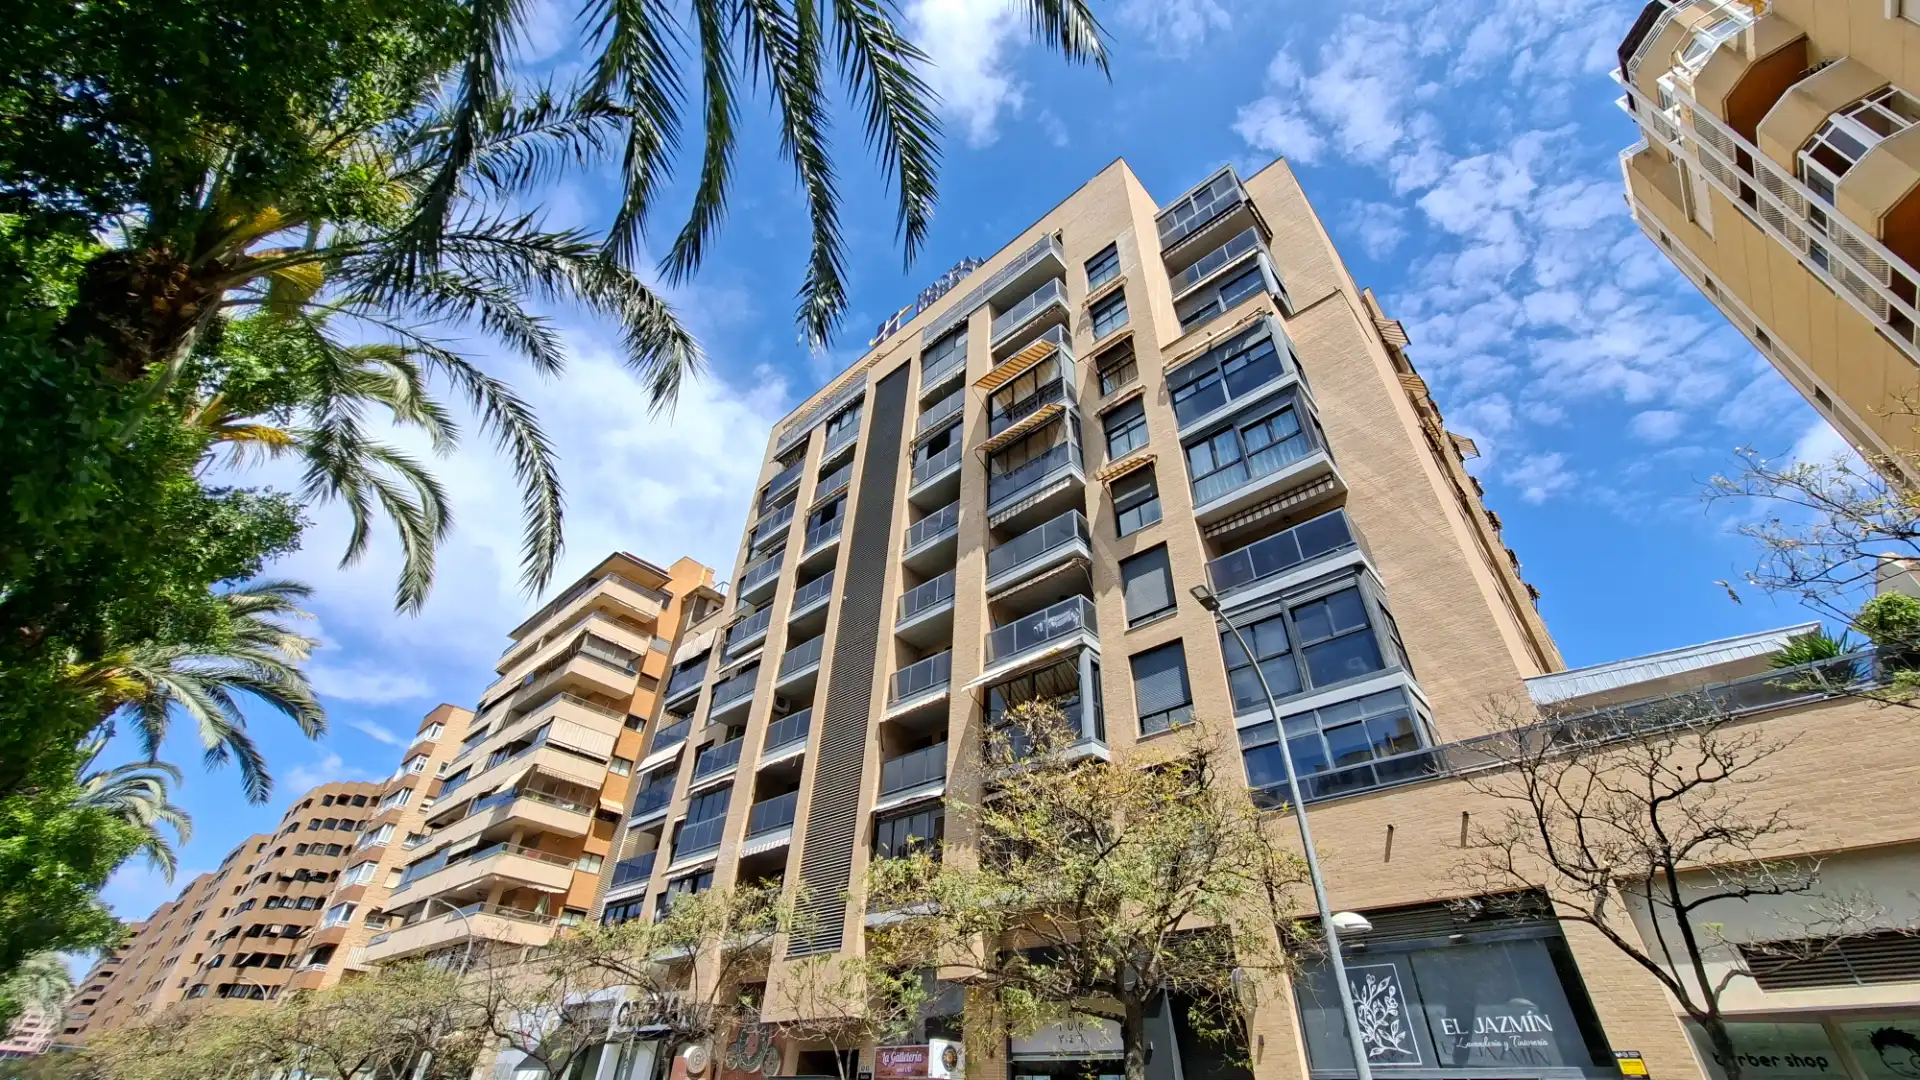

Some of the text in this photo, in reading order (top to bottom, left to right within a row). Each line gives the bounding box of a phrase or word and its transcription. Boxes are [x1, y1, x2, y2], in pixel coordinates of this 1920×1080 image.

[1440, 1010, 1553, 1035] EL JAZMÍN
[1503, 1040, 1509, 1051] y
[882, 1051, 890, 1066] La
[1784, 1052, 1829, 1072] shop
